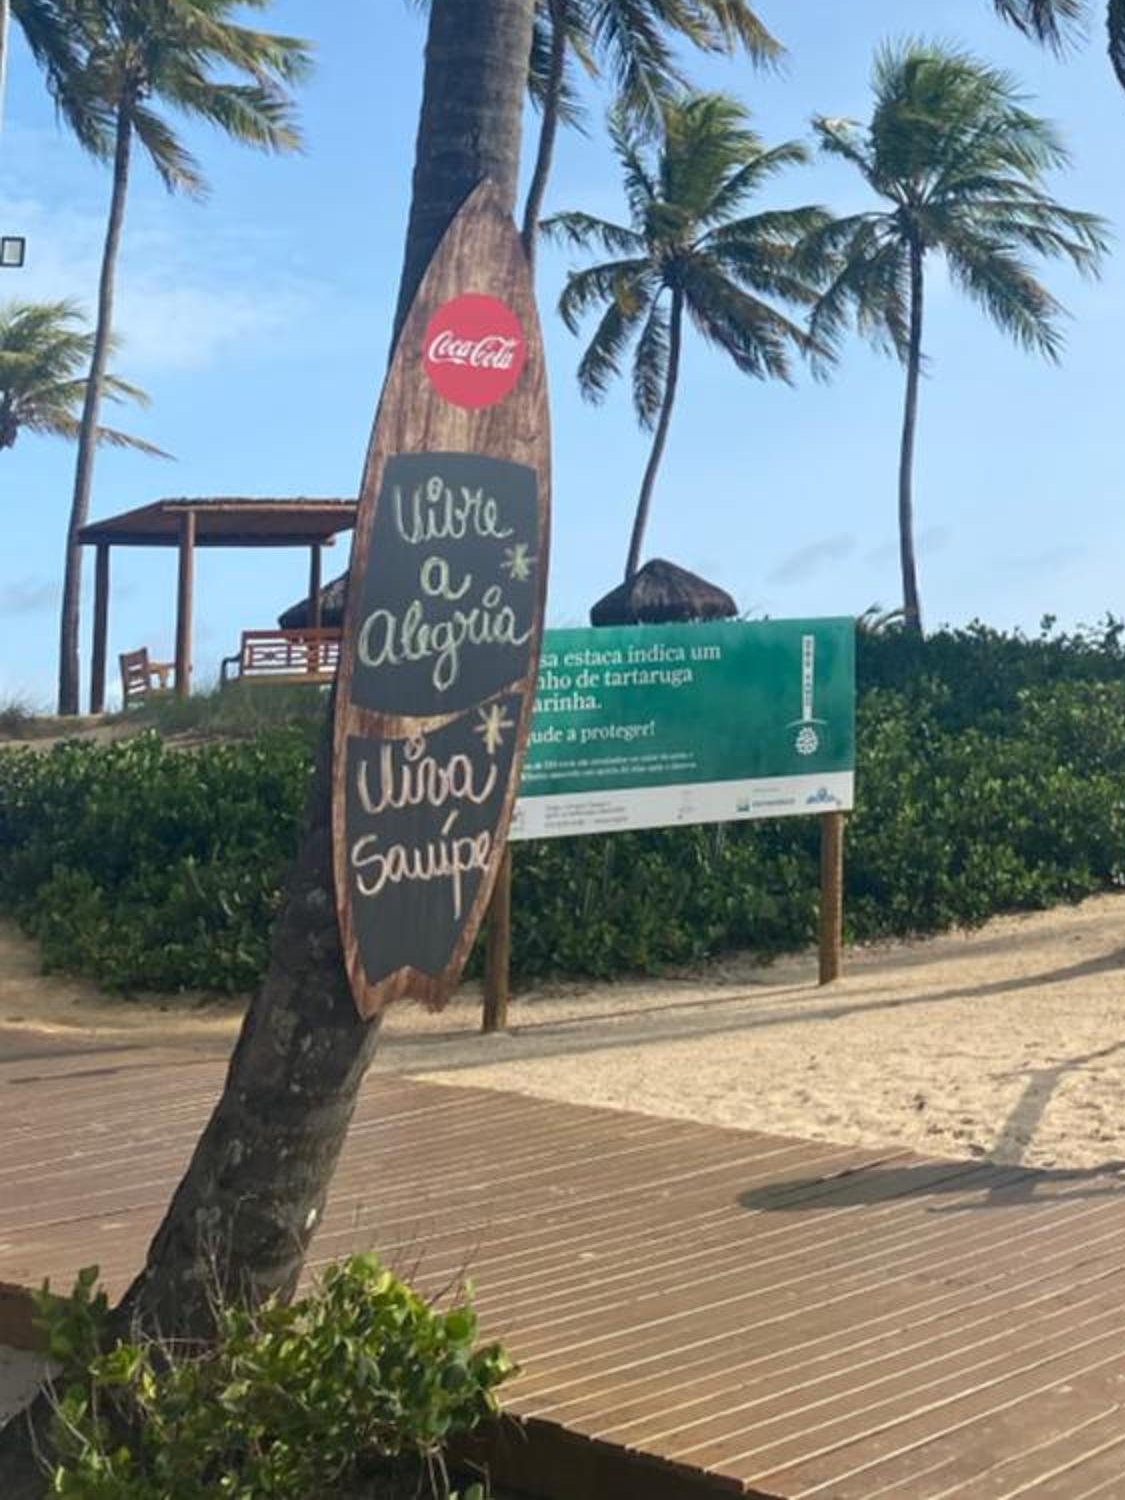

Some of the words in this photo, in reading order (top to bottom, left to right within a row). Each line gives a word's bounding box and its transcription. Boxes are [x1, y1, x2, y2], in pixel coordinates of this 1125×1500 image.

[428, 330, 518, 369] Coca-Cola
[394, 476, 515, 544] Vibre
[420, 556, 472, 600] a
[359, 586, 535, 692] Alegria
[563, 648, 622, 667] estaca
[627, 643, 685, 664] indica
[691, 646, 721, 661] um
[574, 668, 600, 689] de
[604, 667, 693, 688] tartaruga
[532, 691, 602, 713] arinha.
[566, 728, 577, 741] a
[580, 720, 656, 744] proteger!
[358, 736, 498, 814] Viva
